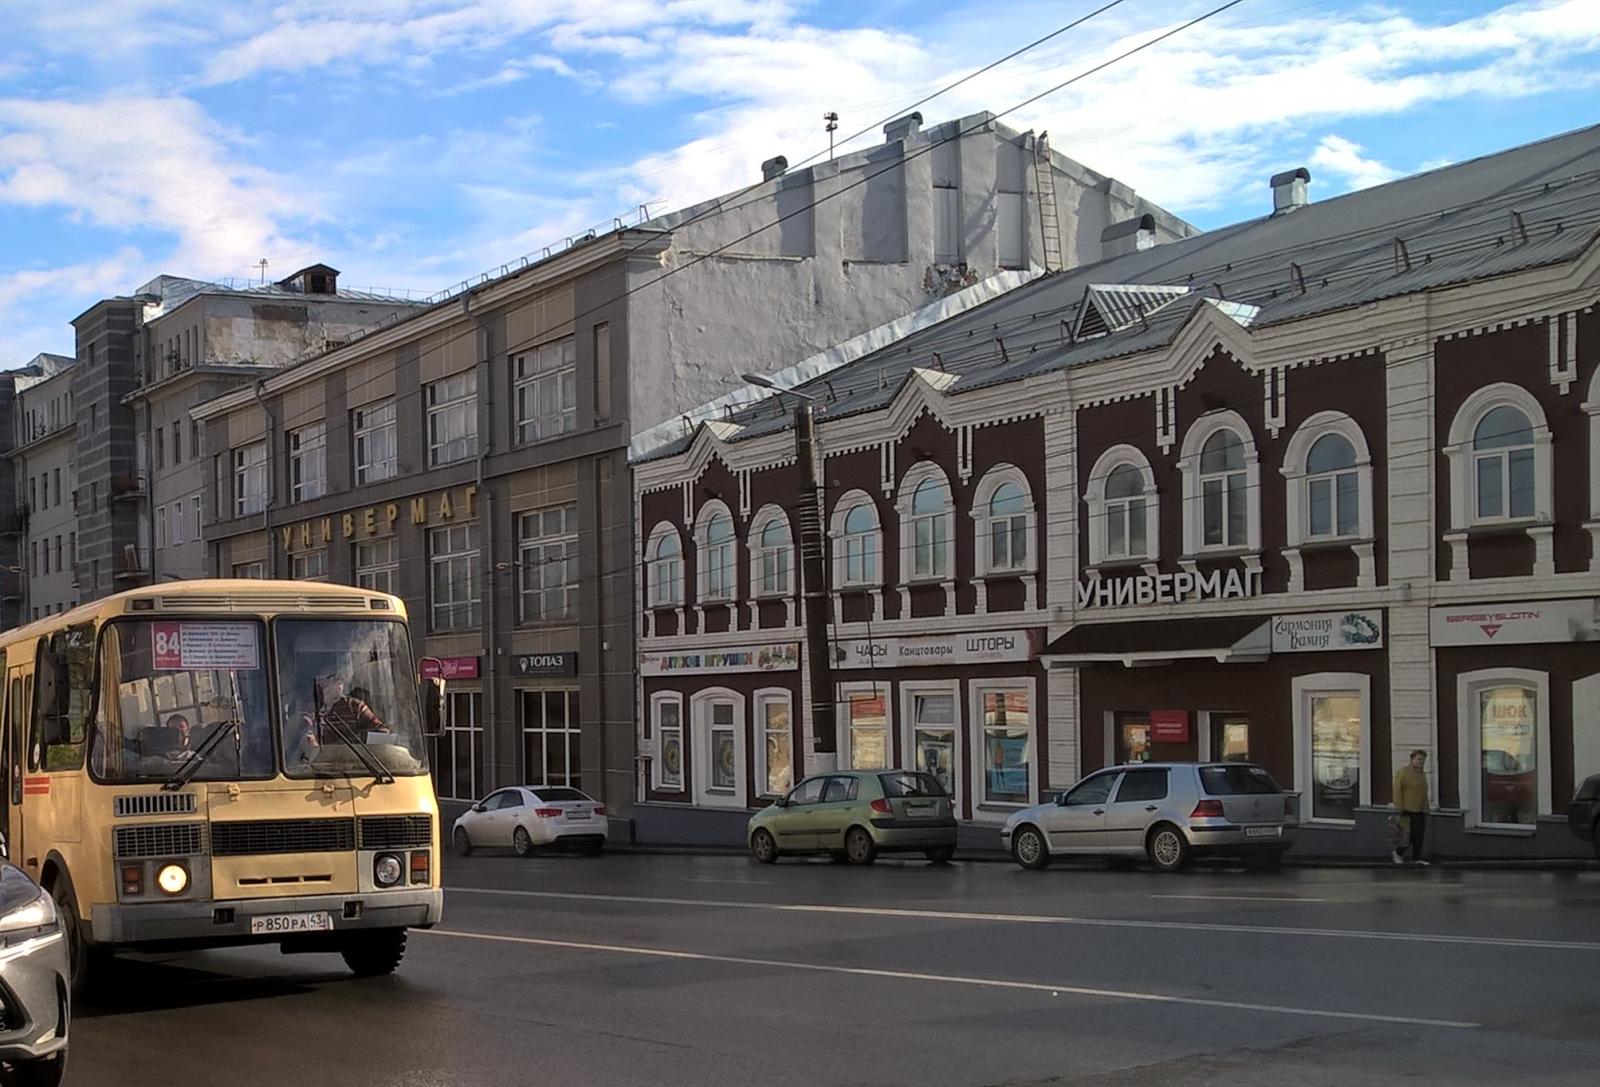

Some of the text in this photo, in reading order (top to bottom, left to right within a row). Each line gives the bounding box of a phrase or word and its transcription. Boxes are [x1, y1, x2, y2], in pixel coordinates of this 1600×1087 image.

[281, 487, 478, 551] УНИВЕРМАГ
[1078, 568, 1261, 607] УНИВЕРМАГ
[156, 632, 180, 655] 84
[856, 637, 1015, 658] ЧАСЫ Канцтовары ШТОРЫ
[529, 656, 563, 667] ТОПАЗ
